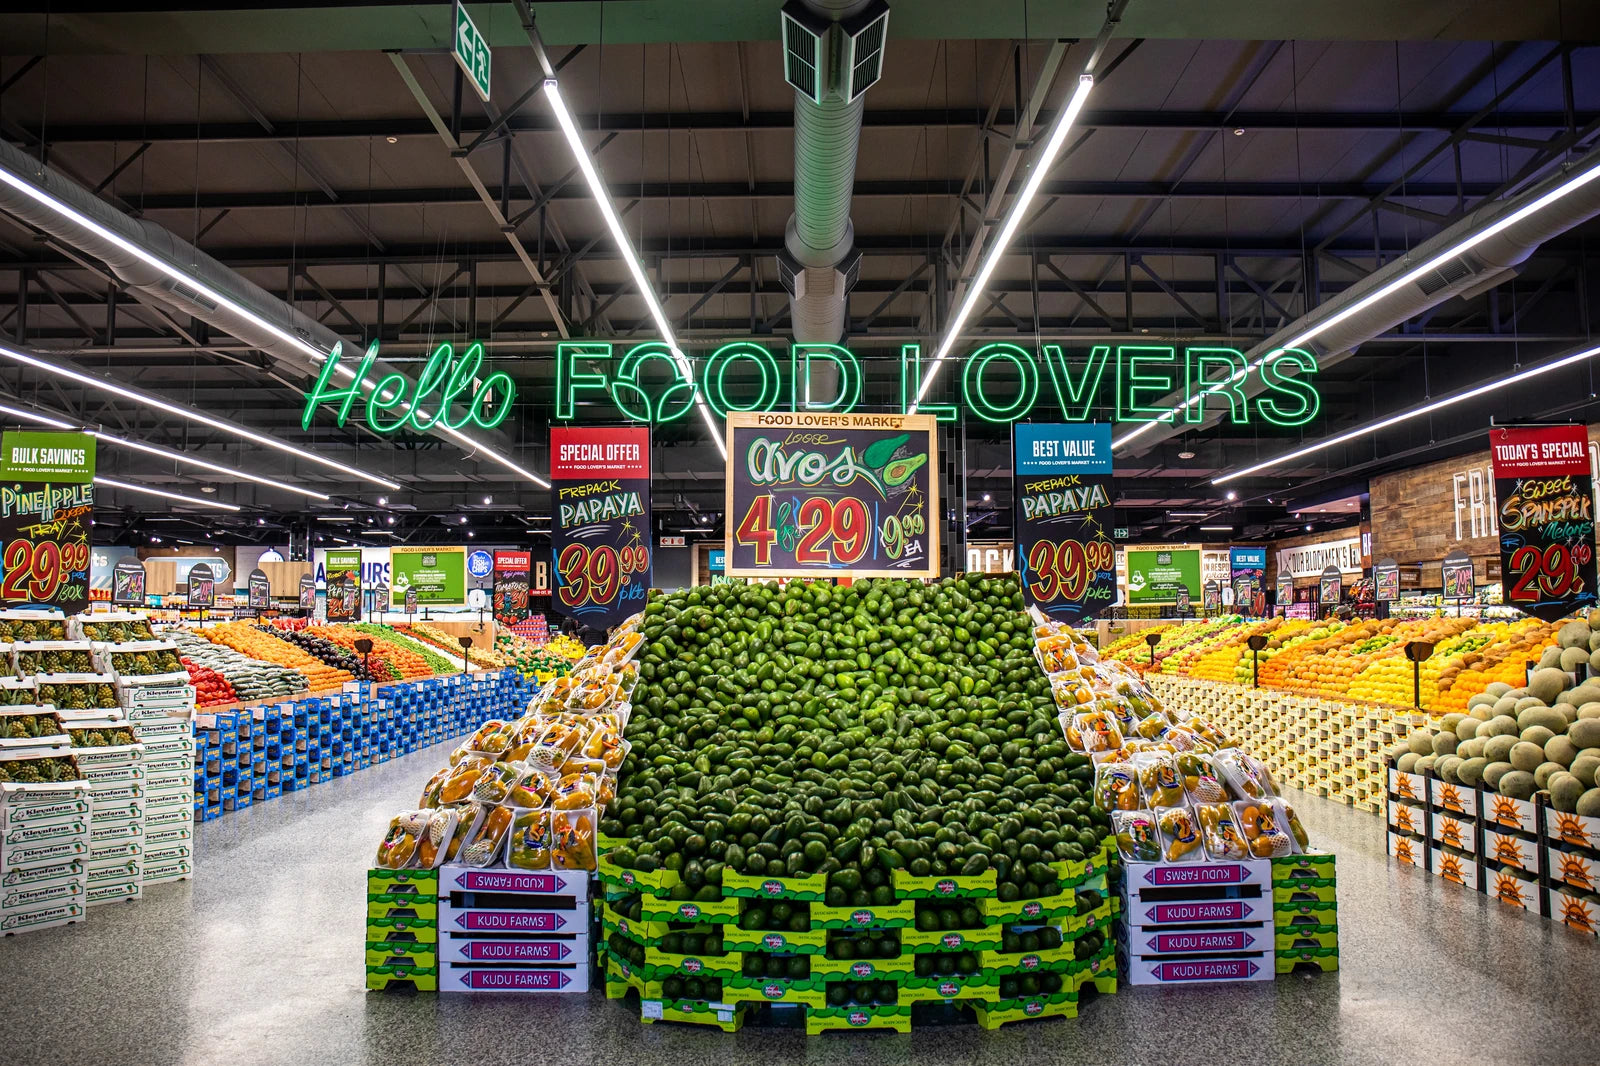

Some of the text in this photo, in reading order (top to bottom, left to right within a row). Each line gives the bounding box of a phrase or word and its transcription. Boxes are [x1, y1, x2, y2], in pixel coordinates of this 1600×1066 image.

[303, 338, 1322, 432] Hello FOOD LOVERS
[758, 415, 904, 428] FOOD LOVER'S MARKET
[12, 447, 85, 465] BULK SAVINGS
[560, 444, 640, 461] SPECIAL OFFER
[1032, 440, 1096, 457] BEST VALUE
[1496, 442, 1584, 461] TODAY'S SPECIAL
[559, 479, 621, 500] PREPACK
[1024, 474, 1081, 494] PREPACK
[1522, 475, 1573, 498] Sweet
[560, 492, 645, 528] PAPAYA
[1022, 484, 1112, 521] PAPAYA
[736, 495, 777, 565] 4
[796, 496, 872, 564] 29
[516, 876, 545, 888] KUDU
[1202, 869, 1230, 879] KUDU
[1167, 906, 1234, 918] KUDU FARMS!
[477, 916, 547, 927] KUDU FARMS!
[1168, 936, 1235, 948] KUDU FARMS!
[482, 946, 551, 956] KUDU FARMS!
[1172, 964, 1240, 976] KUDU FARMS!
[482, 974, 551, 985] KUDU FARMS!
